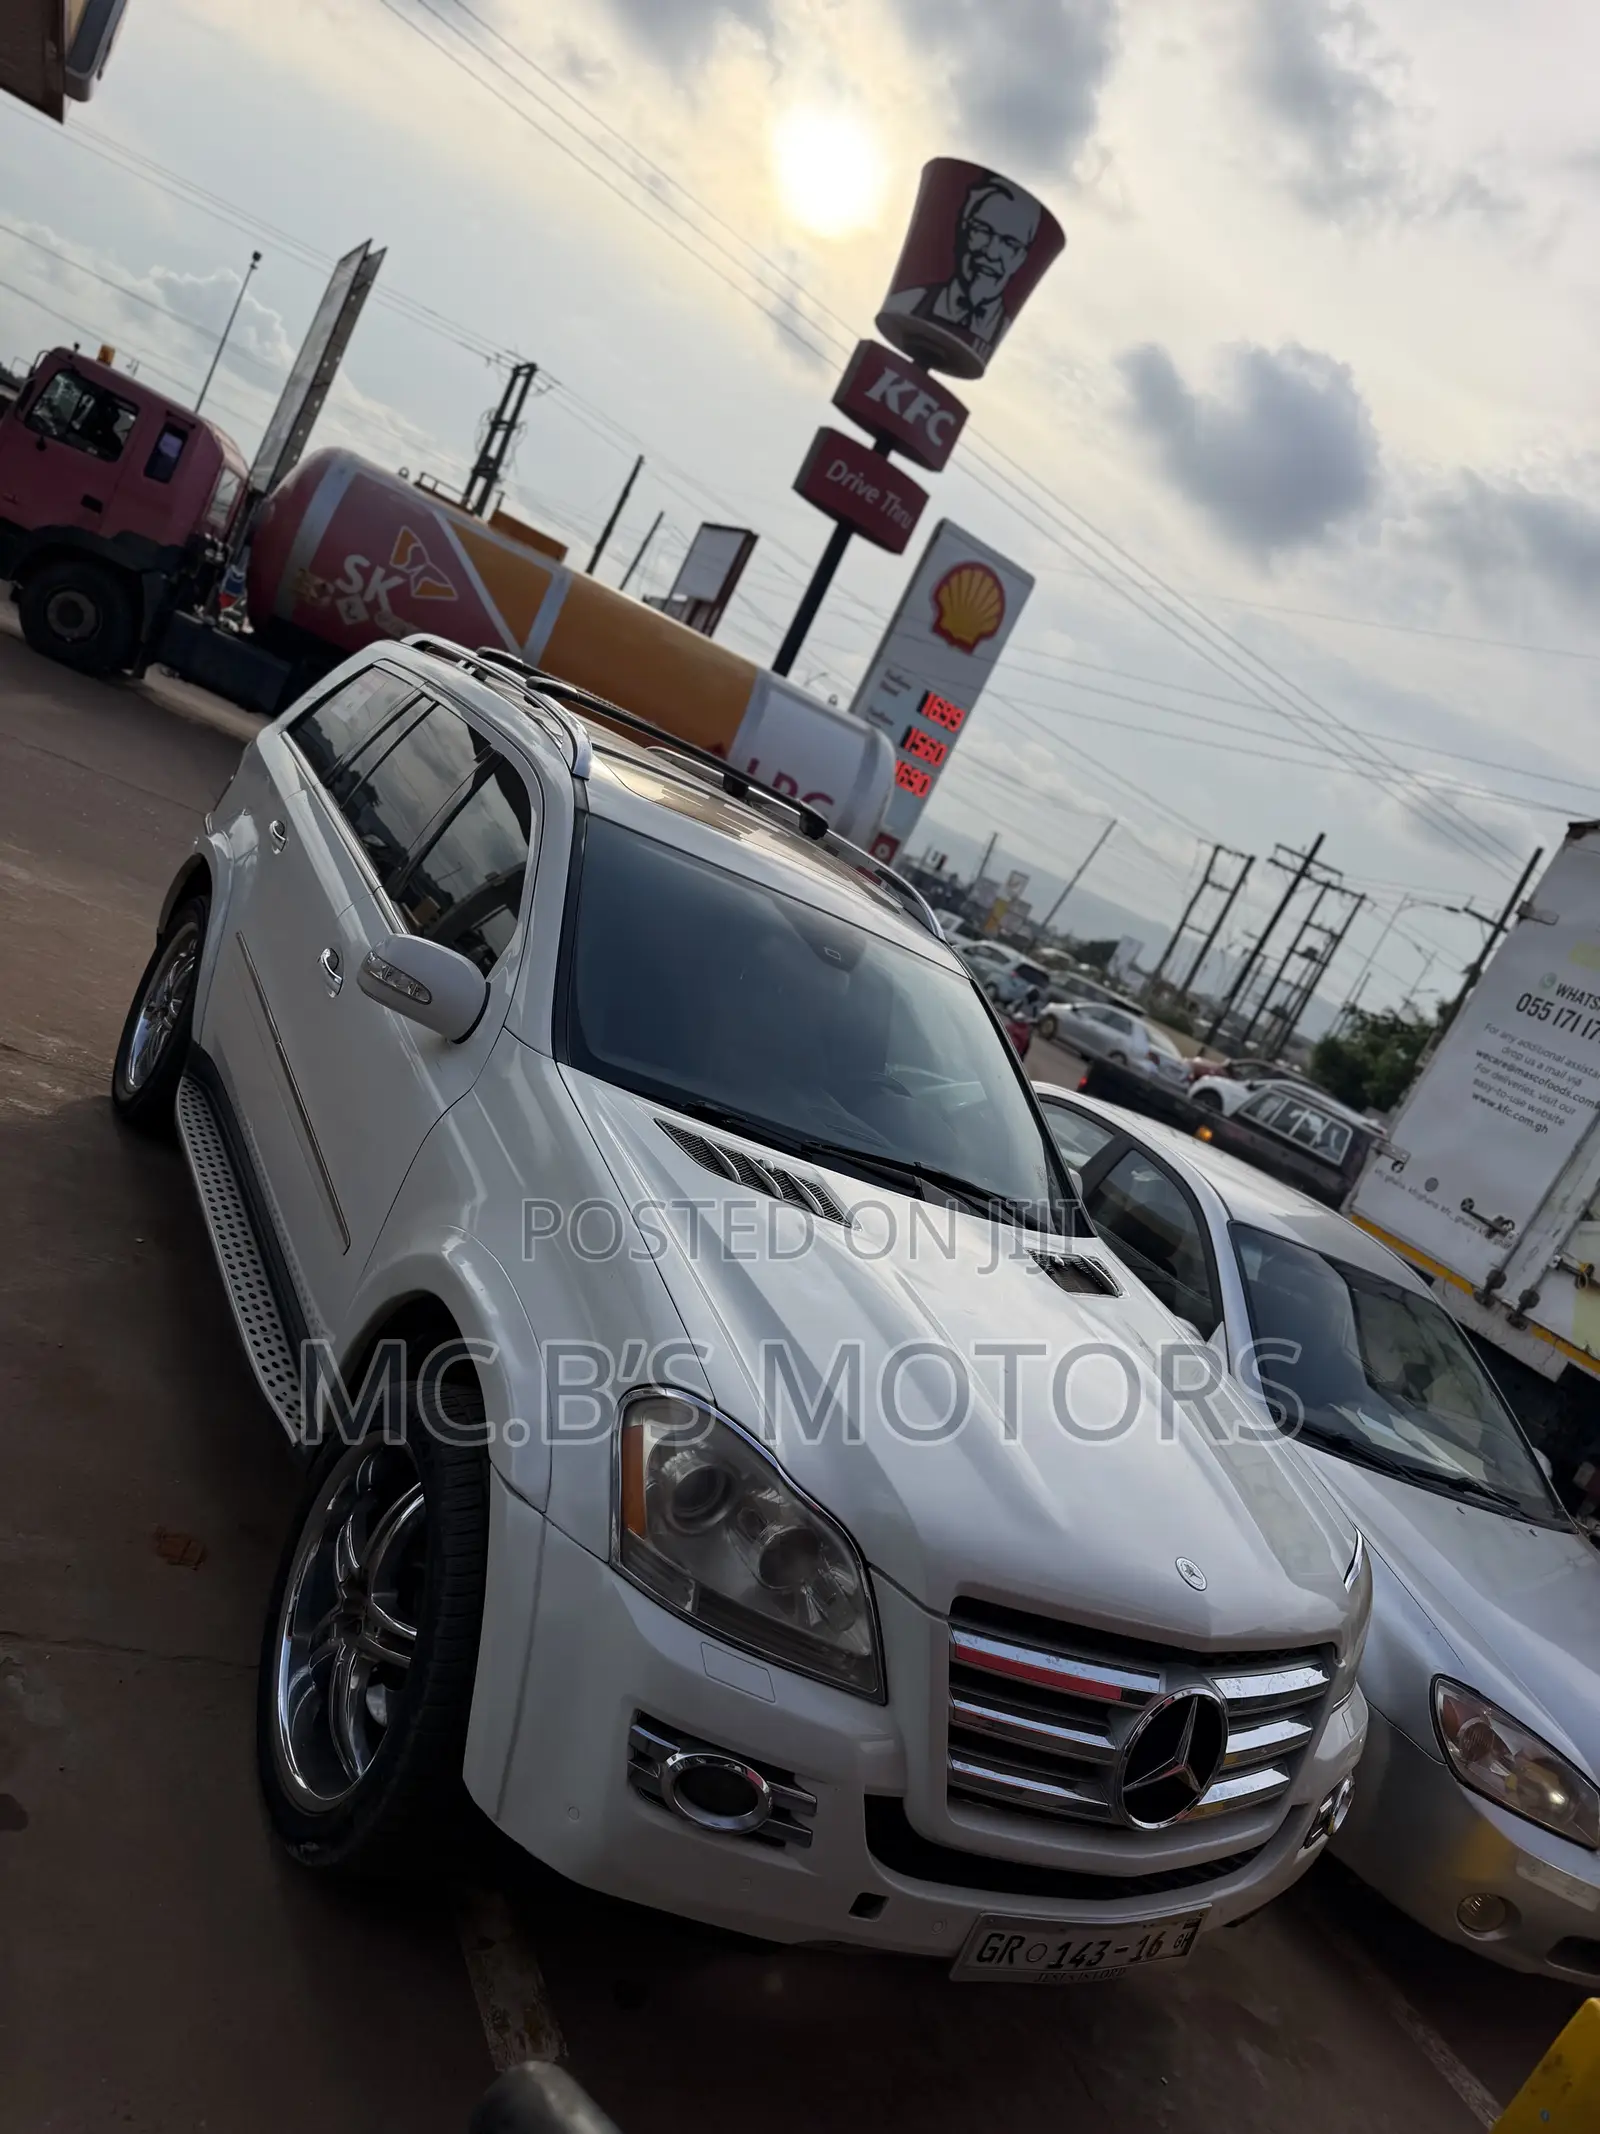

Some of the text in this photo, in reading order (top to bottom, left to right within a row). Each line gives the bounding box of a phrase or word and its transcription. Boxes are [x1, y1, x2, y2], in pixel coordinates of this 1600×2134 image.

[865, 366, 956, 447] KFC
[825, 458, 915, 531] Drive Thru
[335, 554, 406, 611] SK
[1556, 982, 1600, 1011] WHATS
[1484, 1023, 1500, 1035] For
[1516, 992, 1600, 1045] 055 171 17
[1474, 1062, 1491, 1075] For
[1501, 1045, 1524, 1061] drop
[1472, 1092, 1549, 1134] www.kfc.com.gh
[1527, 1103, 1566, 1127] website
[976, 1931, 1165, 1970] GR 143-16
